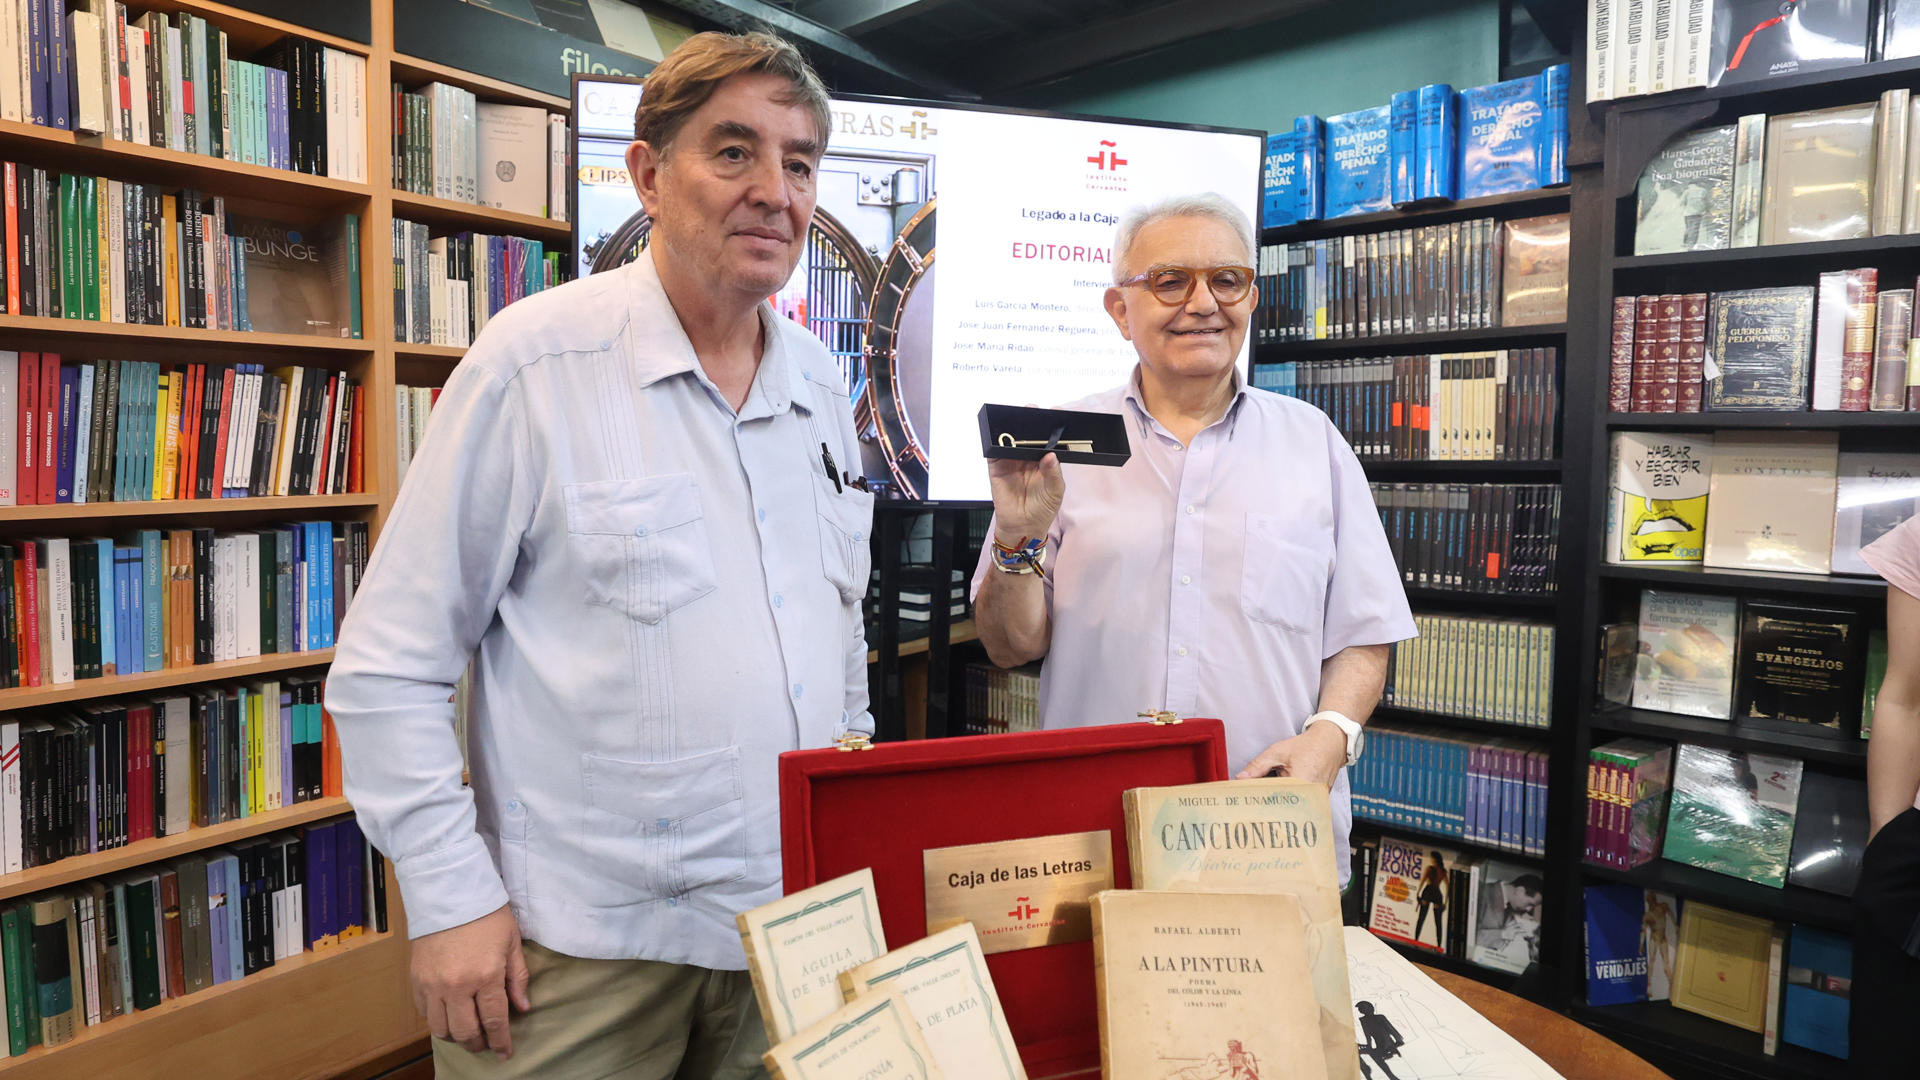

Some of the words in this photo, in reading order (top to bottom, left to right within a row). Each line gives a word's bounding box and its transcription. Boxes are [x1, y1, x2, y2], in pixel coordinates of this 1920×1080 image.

[1770, 61, 1798, 70] ANAYA
[1472, 100, 1534, 121] TRATADO
[1472, 116, 1534, 136] DERECHO
[1334, 129, 1387, 147] TRATADO
[1480, 130, 1522, 146] PENAL
[1334, 144, 1387, 162] DERECHO
[1341, 156, 1378, 170] PENAL
[1355, 182, 1364, 190] V
[1022, 208, 1066, 221] Legado
[1069, 212, 1076, 221] a
[1080, 212, 1090, 222] la
[1093, 213, 1119, 226] Caja
[244, 236, 319, 262] BUNGE
[1012, 242, 1112, 264] EDITORIAL
[1728, 334, 1792, 343] PELOPONESO
[1730, 328, 1768, 336] GUERRA
[167, 413, 178, 447] SARTRE
[1646, 445, 1691, 460] HABLAR
[1636, 460, 1642, 472] Y
[1645, 460, 1701, 474] ESCRIBIR
[1673, 546, 1702, 558] open
[1756, 652, 1844, 671] EVANGELIOS
[1178, 796, 1220, 806] MIGUEL
[1225, 796, 1240, 806] DE
[1244, 795, 1300, 806] UNAMUNO
[1161, 820, 1318, 851] CANCIONERO
[1382, 844, 1422, 865] HONG
[948, 871, 985, 890] Caja
[990, 868, 1010, 883] de
[1015, 865, 1038, 880] las
[1043, 859, 1092, 876] Letras
[1380, 857, 1422, 880] KONG
[982, 924, 1024, 936] Instituto
[1154, 926, 1192, 935] RAFAEL
[1198, 927, 1241, 936] ALBERTI
[1138, 956, 1150, 972] A
[1154, 956, 1177, 972] LA
[1181, 956, 1264, 973] PINTURA
[1596, 962, 1648, 979] VENDAJES
[792, 984, 810, 1000] DE
[926, 1014, 943, 1027] DE
[946, 996, 978, 1018] PLATA
